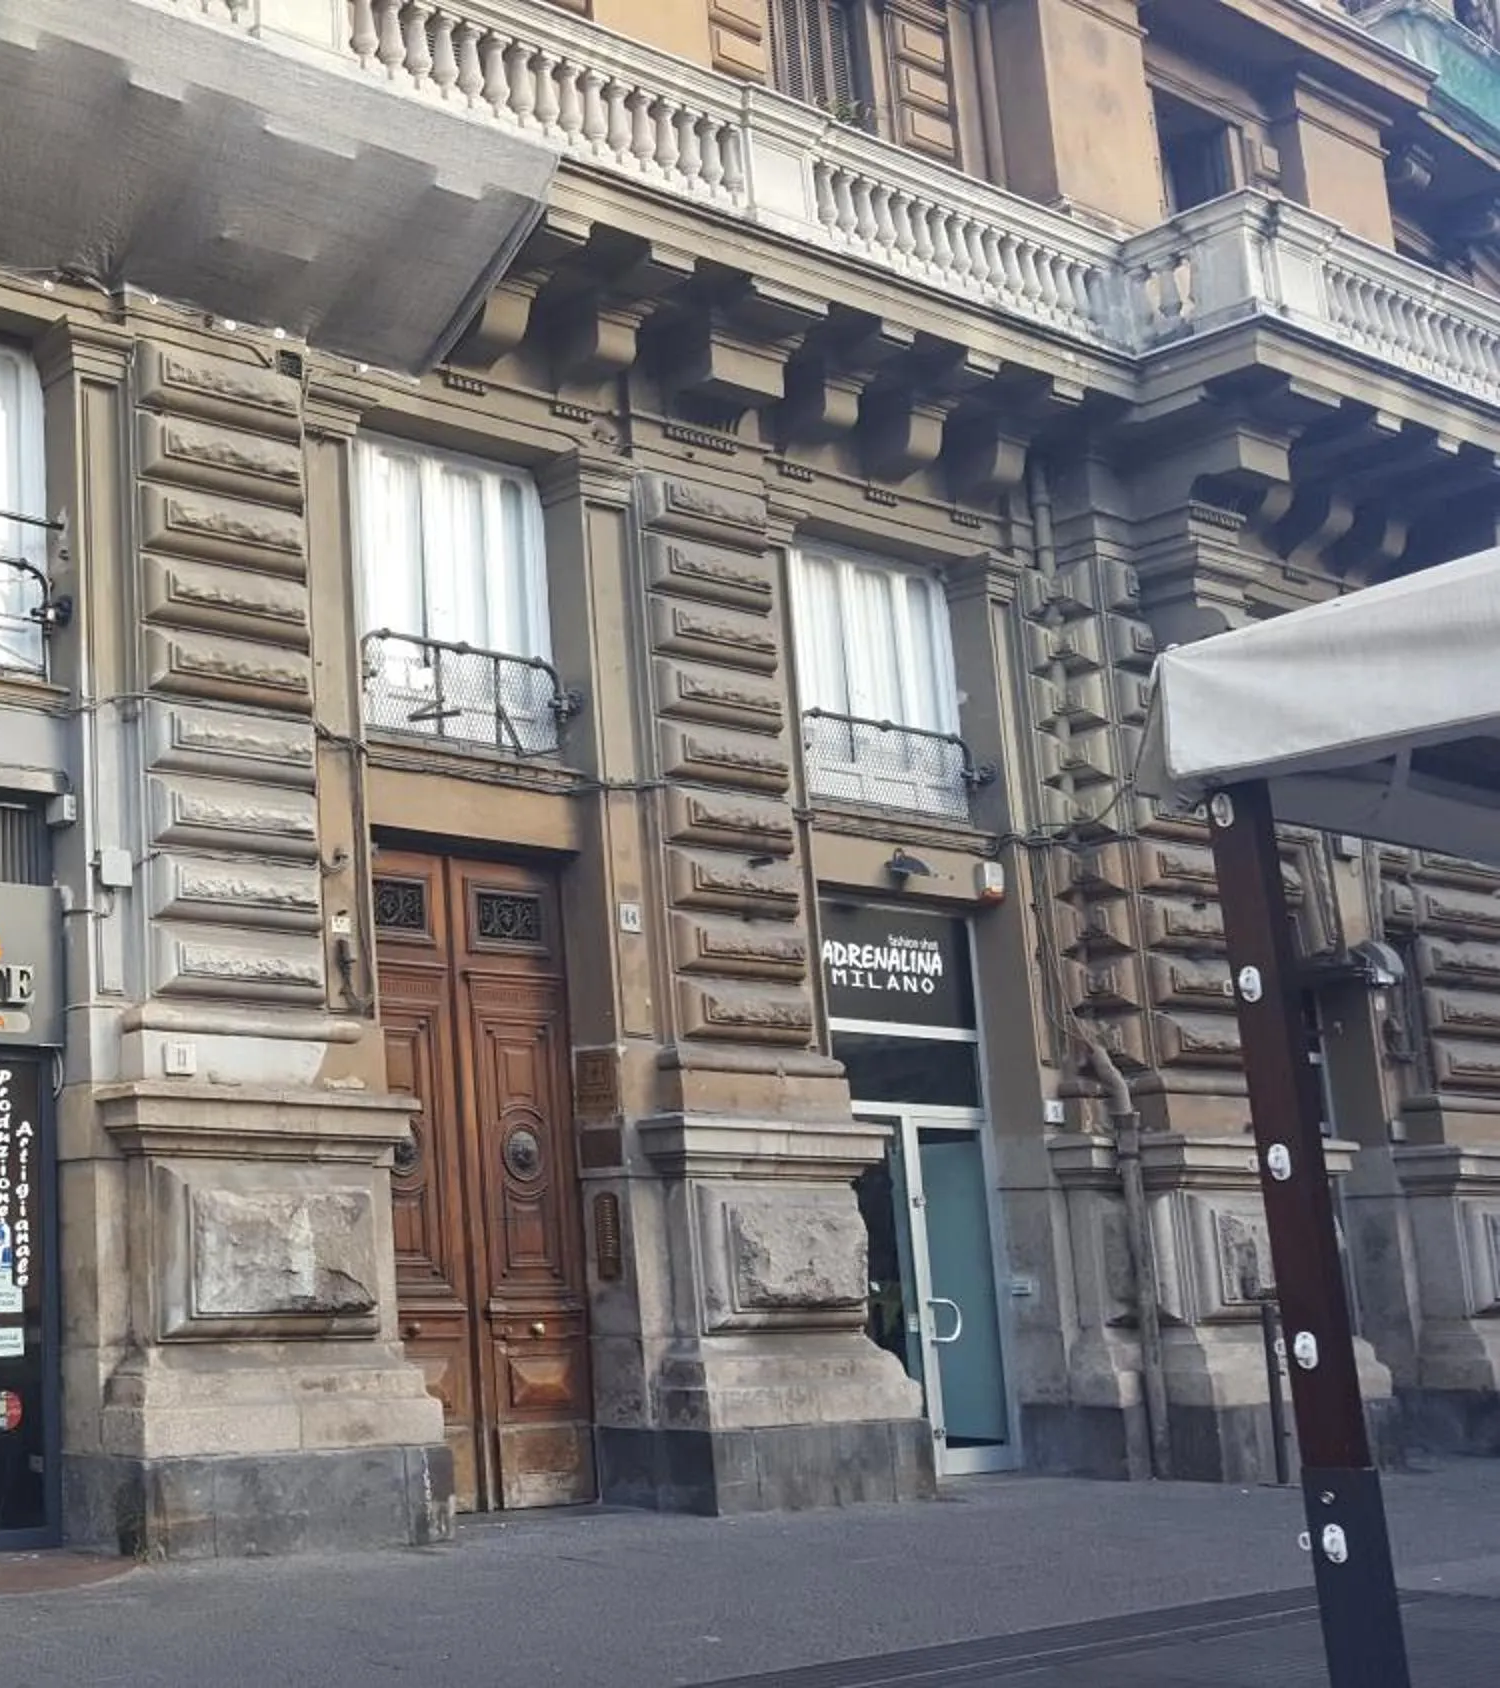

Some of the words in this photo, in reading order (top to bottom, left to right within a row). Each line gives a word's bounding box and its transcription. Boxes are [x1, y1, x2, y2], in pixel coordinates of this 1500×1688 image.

[821, 940, 943, 977] ADRENALINA
[831, 968, 935, 995] MILANO
[15, 1120, 34, 1286] Artigianale
